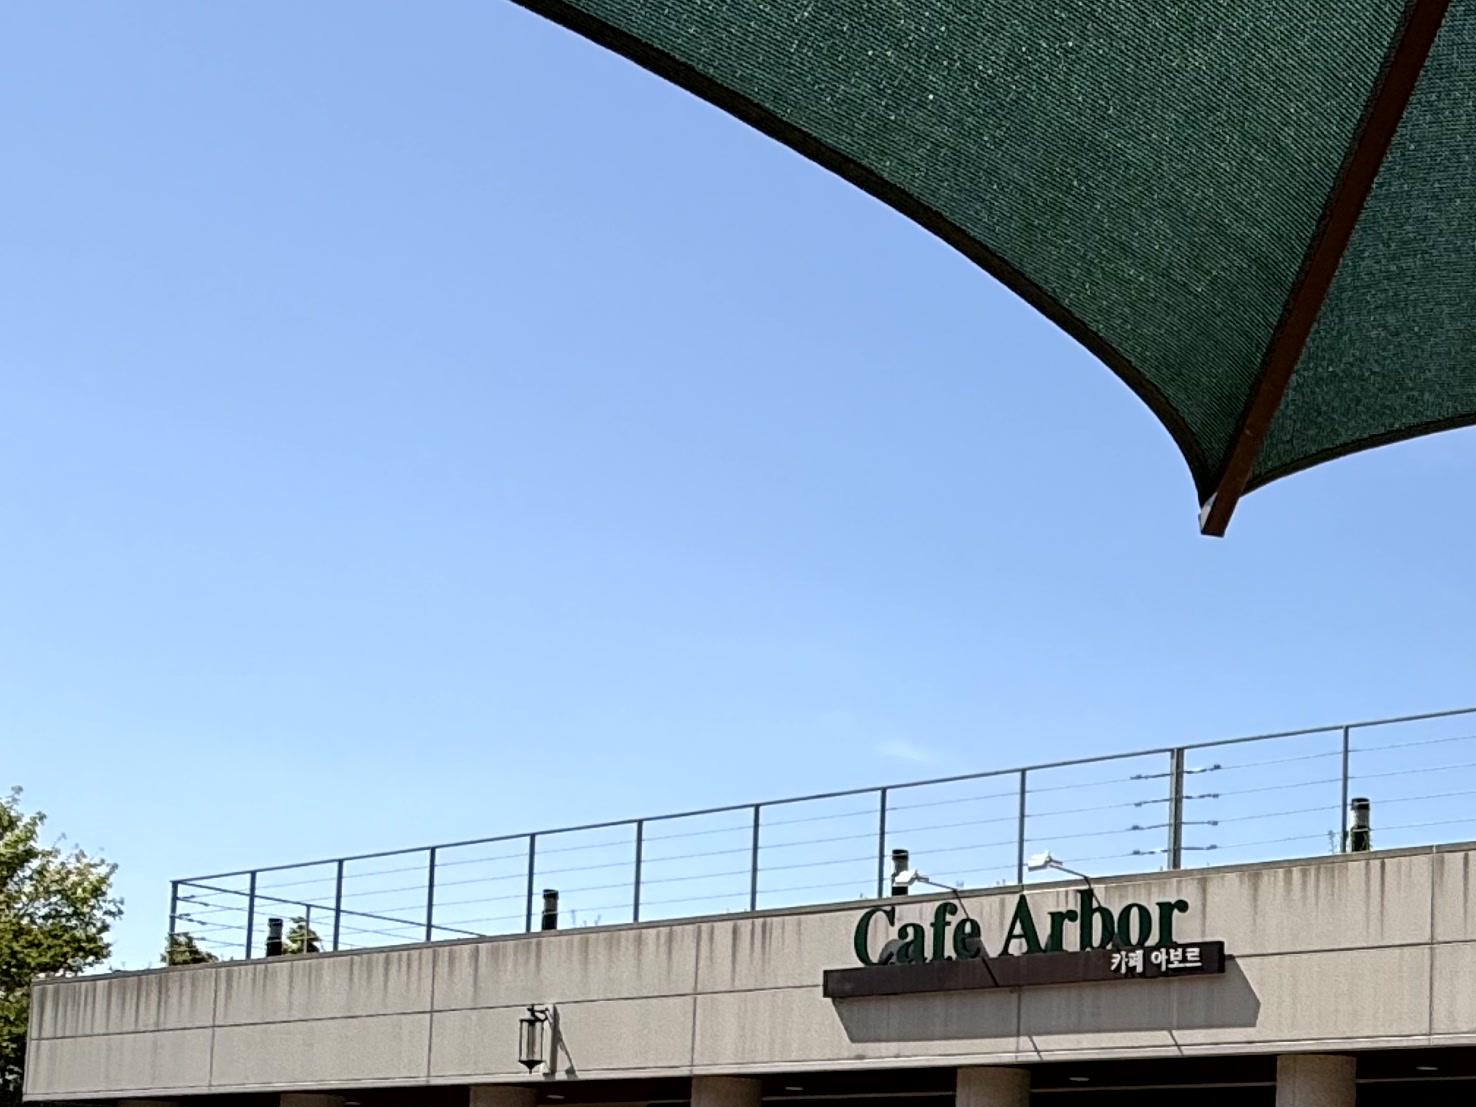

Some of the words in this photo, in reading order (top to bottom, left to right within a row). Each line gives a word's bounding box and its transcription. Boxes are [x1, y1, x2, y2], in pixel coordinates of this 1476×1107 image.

[853, 901, 982, 967] Cafe
[999, 889, 1190, 957] Arbor
[1110, 949, 1144, 974] 카페
[1151, 947, 1203, 972] 아보르
